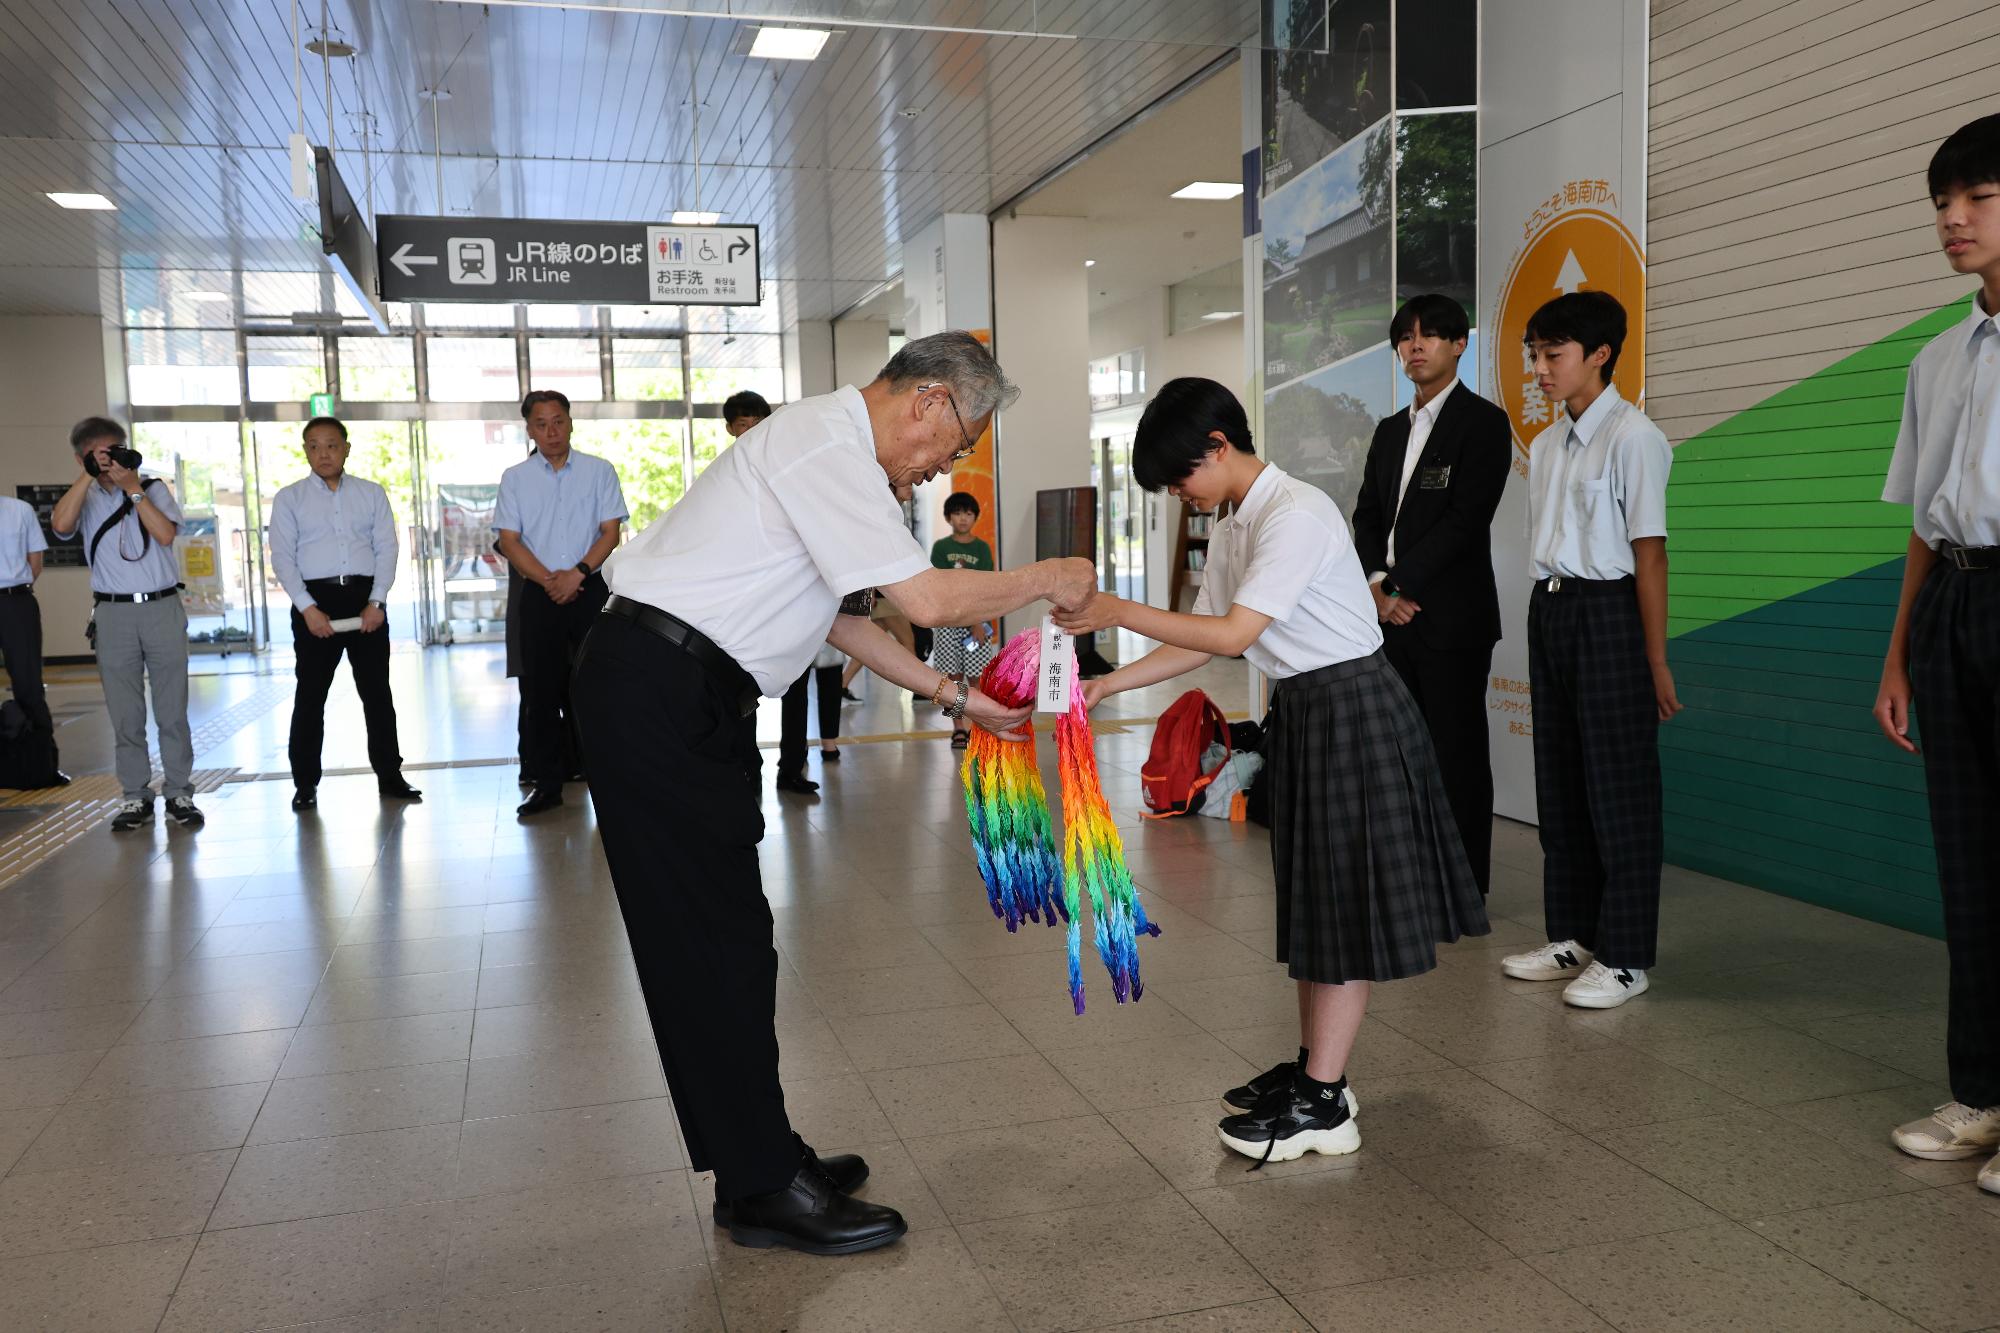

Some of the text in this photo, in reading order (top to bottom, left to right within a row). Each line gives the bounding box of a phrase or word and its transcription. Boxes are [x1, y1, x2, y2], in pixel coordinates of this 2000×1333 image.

[1522, 179, 1617, 240] ようこそ海南市へ
[506, 241, 643, 265] JR線のりば
[507, 266, 570, 284] JR Line
[657, 269, 703, 285] お手洗
[657, 285, 708, 295] Restroom
[1047, 662, 1062, 702] 海南市
[1554, 950, 1579, 968] N
